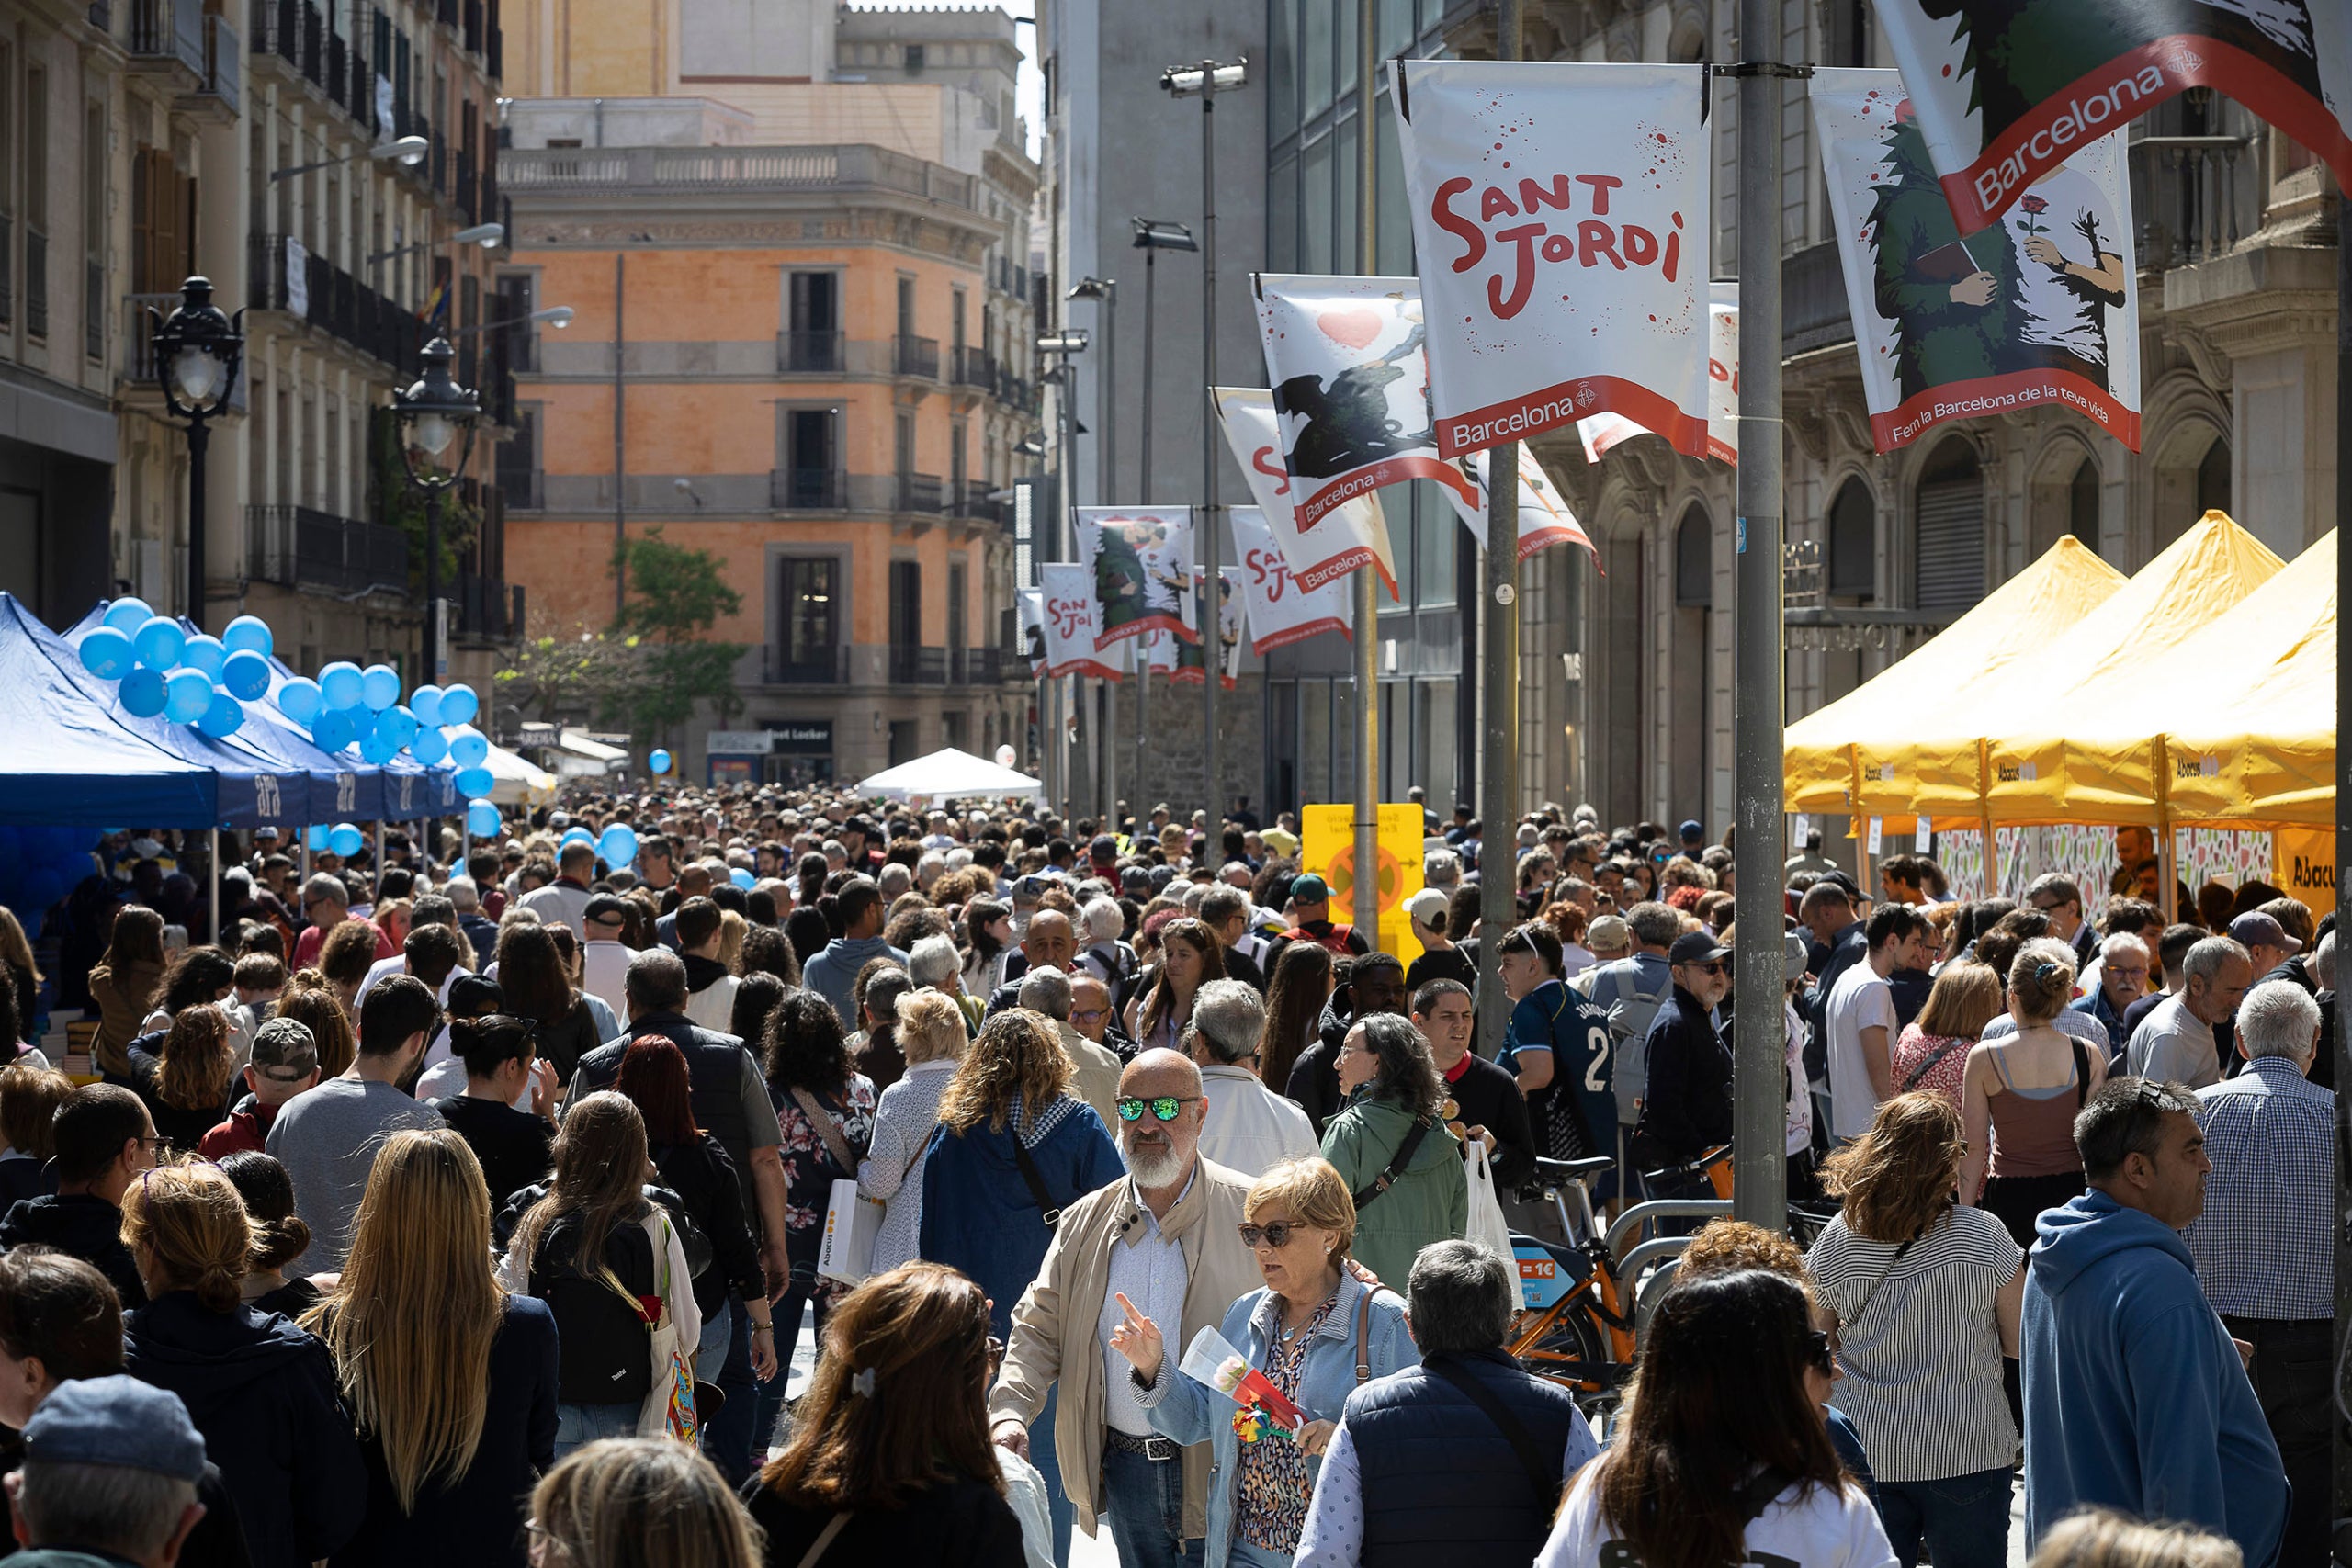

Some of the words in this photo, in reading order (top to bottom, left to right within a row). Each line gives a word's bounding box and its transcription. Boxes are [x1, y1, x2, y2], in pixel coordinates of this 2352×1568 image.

[1974, 65, 2164, 211] Barcelona
[1430, 173, 1623, 274] SANT
[1453, 396, 1575, 449] Barcelona
[1893, 419, 1922, 444] Fem
[1920, 410, 1934, 425] la
[1935, 393, 2016, 418] Barcelona
[2018, 387, 2041, 402] de
[2043, 384, 2058, 398] la
[2060, 386, 2087, 410] teva
[2088, 401, 2109, 425] vida
[1306, 474, 1374, 522] Barcelona
[1246, 548, 1286, 585] SA
[1305, 550, 1372, 588] Barcelona
[1047, 598, 1088, 626] SAN
[791, 728, 829, 740] Locker
[1997, 762, 2020, 782] Abacus
[2177, 757, 2201, 779] Abacus
[2293, 855, 2336, 889] Abacu
[856, 1192, 871, 1203] acus
[823, 1235, 833, 1266] Abacus
[1535, 1263, 1553, 1276] 1€
